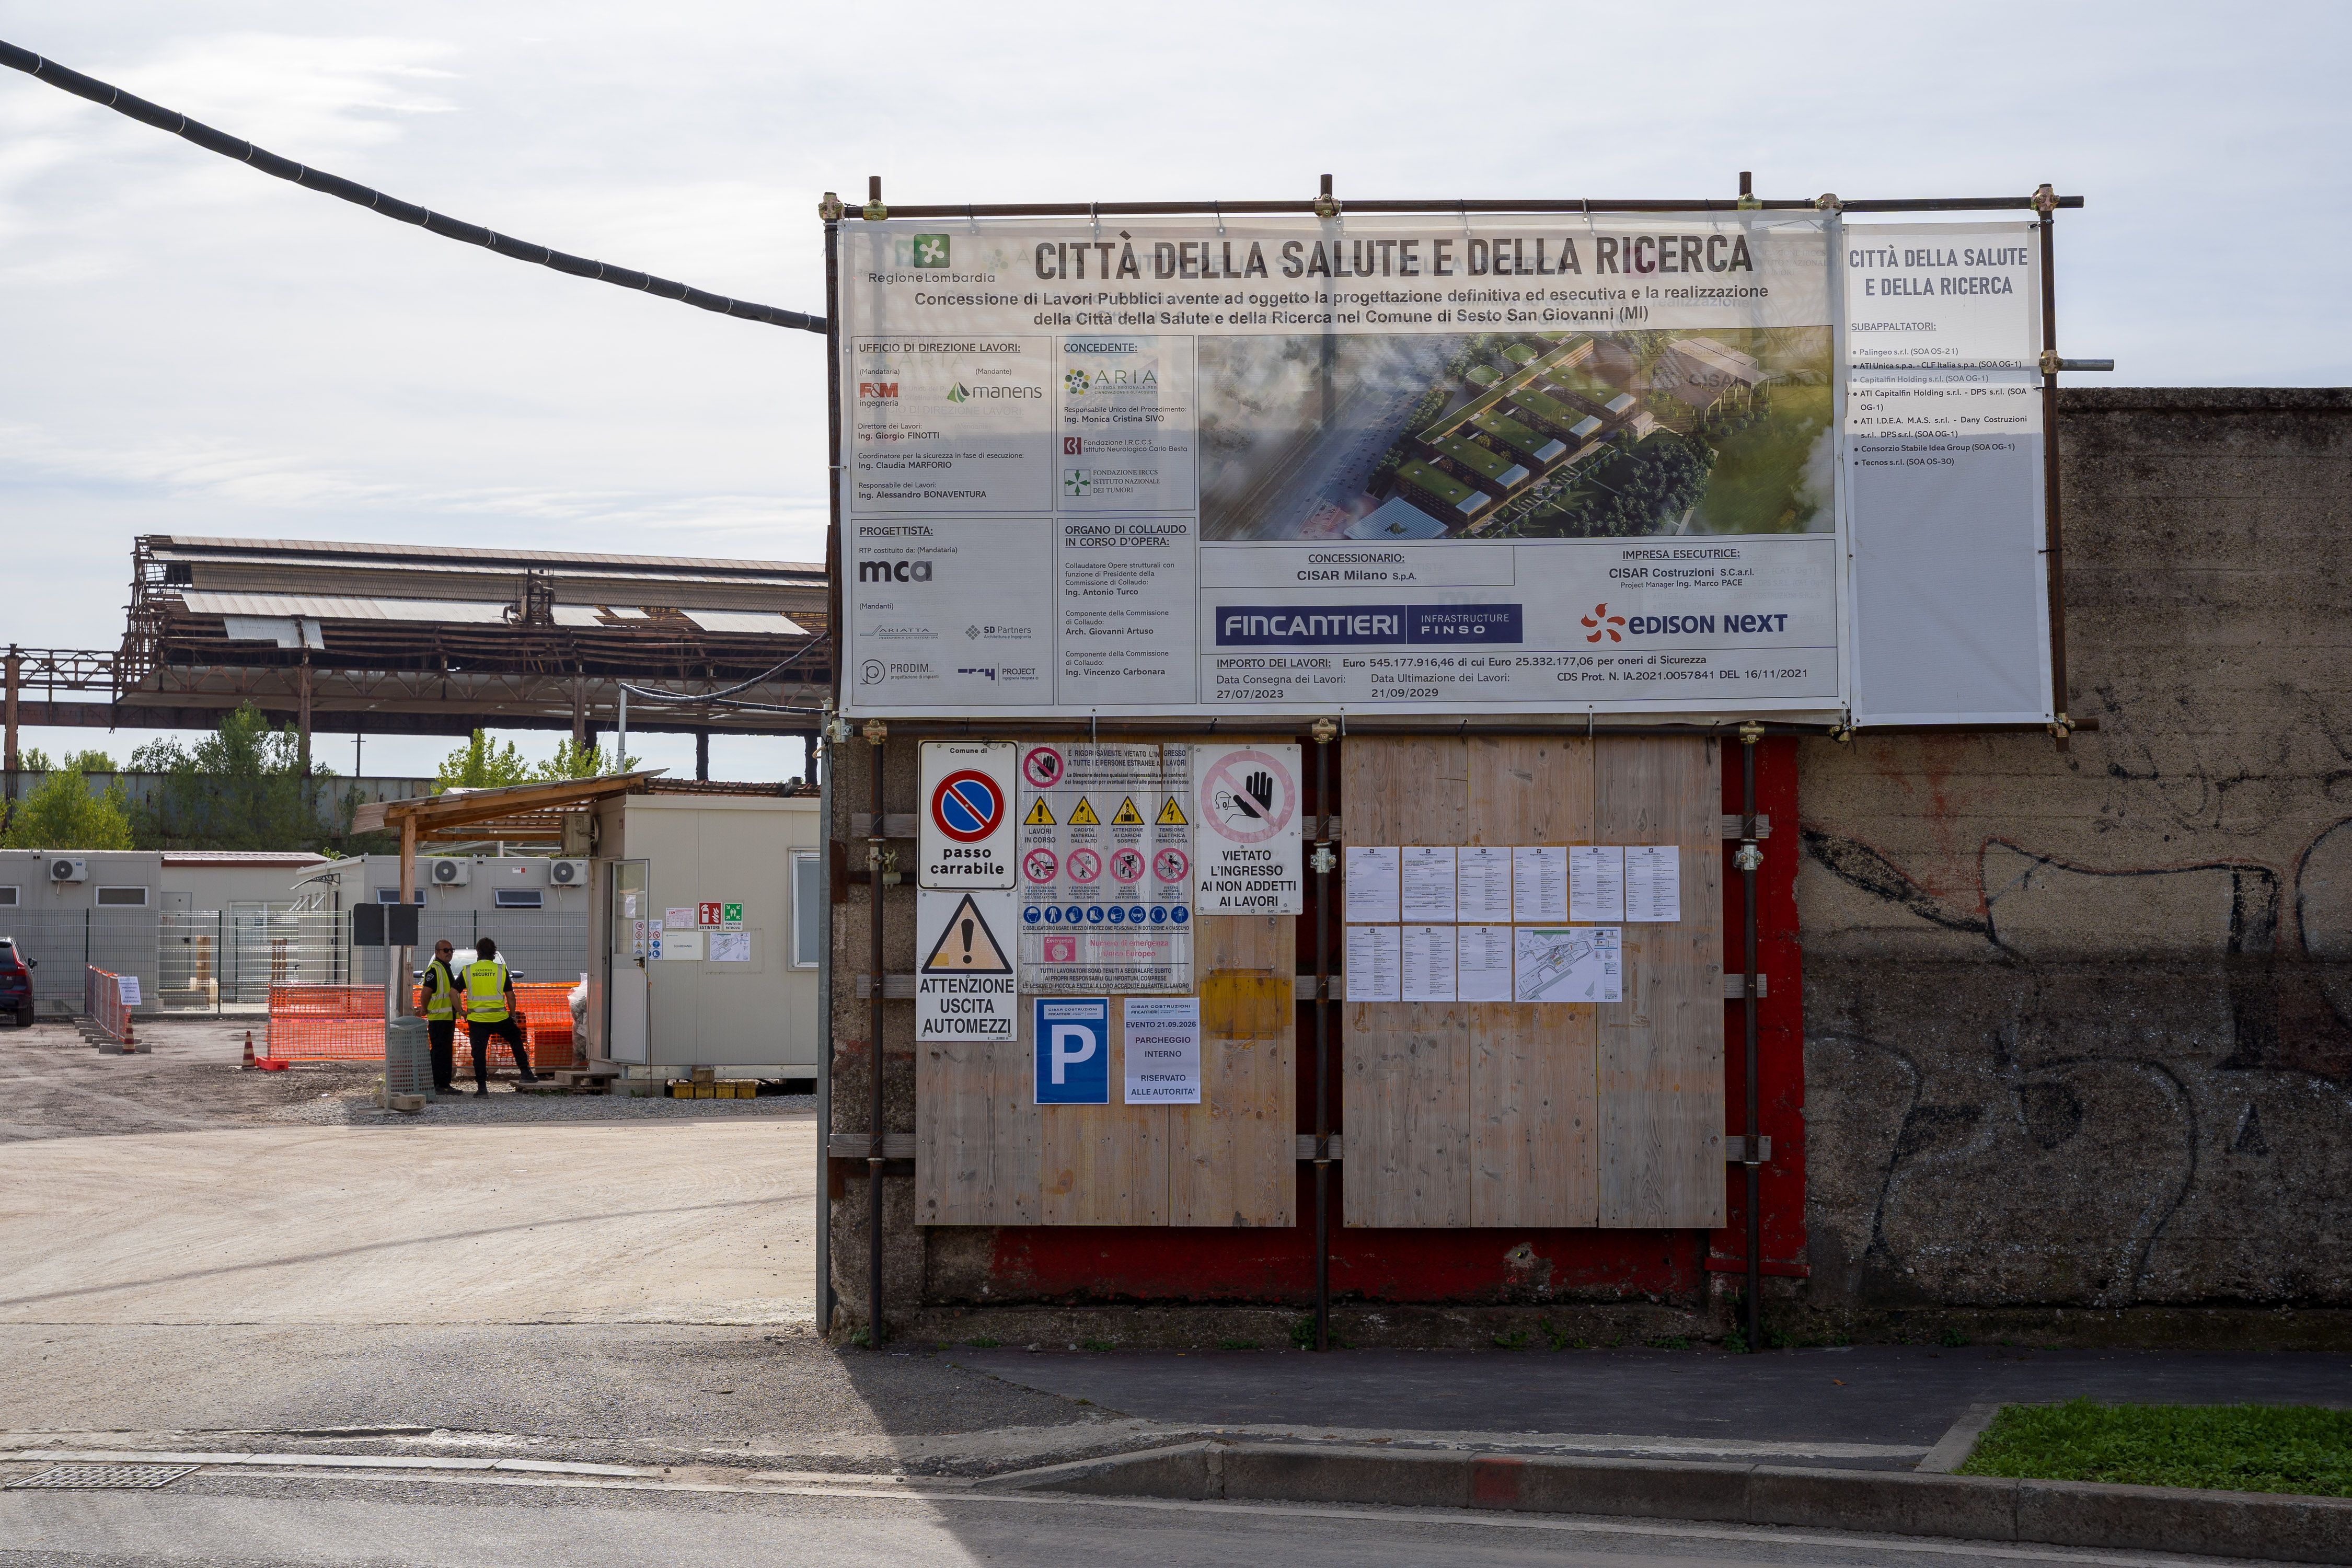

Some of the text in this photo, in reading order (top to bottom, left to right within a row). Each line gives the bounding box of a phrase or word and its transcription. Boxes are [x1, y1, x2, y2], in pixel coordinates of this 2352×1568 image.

[1035, 230, 1754, 280] CITTÀ DELLA SALUTE E DELLA RICERCA
[1849, 244, 2028, 268] CITTÀ DELLA SALUTE
[1865, 276, 2013, 296] E DELLA RICERCA
[915, 284, 1769, 307] Concessione di Lavori Pubblici avente ad oggetto la progettazione definitiva ed esecutiva e la realizzazione
[1033, 306, 1648, 325] della Città della Salute e della Ricerca nel Comune di Sesto San Giovanni (MI)
[1851, 322, 1936, 331] SUBAPPALTATORI:
[859, 343, 1020, 352] UFFICIO DI DIREZIONE LAVORI:
[1064, 343, 1137, 352] CONCEDENTE:
[1860, 349, 1893, 357] Palingeo
[1910, 348, 1930, 356] (SOA
[1931, 347, 1958, 356] OS-21)
[859, 368, 900, 376] (Mandataria)
[1095, 370, 1157, 384] ARIA
[860, 383, 898, 398] F&M
[973, 386, 1042, 399] manens
[1064, 416, 1079, 424] Ing.
[858, 432, 873, 441] Ing.
[875, 432, 905, 441] Giorgio
[1906, 458, 1926, 467] (SOA
[1926, 457, 1954, 466] OS-30)
[860, 526, 933, 535] PROGETTISTA:
[1065, 524, 1187, 534] ORGANO DI COLLAUDO
[1308, 553, 1405, 563] CONCESSIONARIO:
[1623, 548, 1740, 559] IMPRESA ESECUTRICE:
[859, 561, 932, 582] mca
[1297, 570, 1417, 582] CISAR Milano S.p.A.
[1609, 568, 1754, 579] CISAR Costruzioni S.C.a.r.l.
[1065, 589, 1080, 597] Ing.
[1421, 614, 1509, 622] INFRASTRUCTURE
[1225, 615, 1398, 636] FINCANTIERI
[1421, 626, 1485, 634] FINSO
[891, 664, 929, 673] PRODIM
[1217, 689, 1284, 699] 27/07/2023
[1371, 688, 1439, 698] 21/09/2029
[943, 848, 991, 860] passo
[1221, 850, 1272, 861] VIETATO
[930, 862, 1004, 875] carrabile
[1211, 865, 1283, 877] L'INGRESSO
[1201, 880, 1296, 892] AI NON ADDETTI
[1219, 895, 1278, 907] AI LAVORI
[919, 978, 1014, 994] ATTENZIONE
[940, 998, 995, 1013] USCITA
[923, 1018, 1011, 1033] AUTOMEZZI
[1052, 1024, 1096, 1084] P
